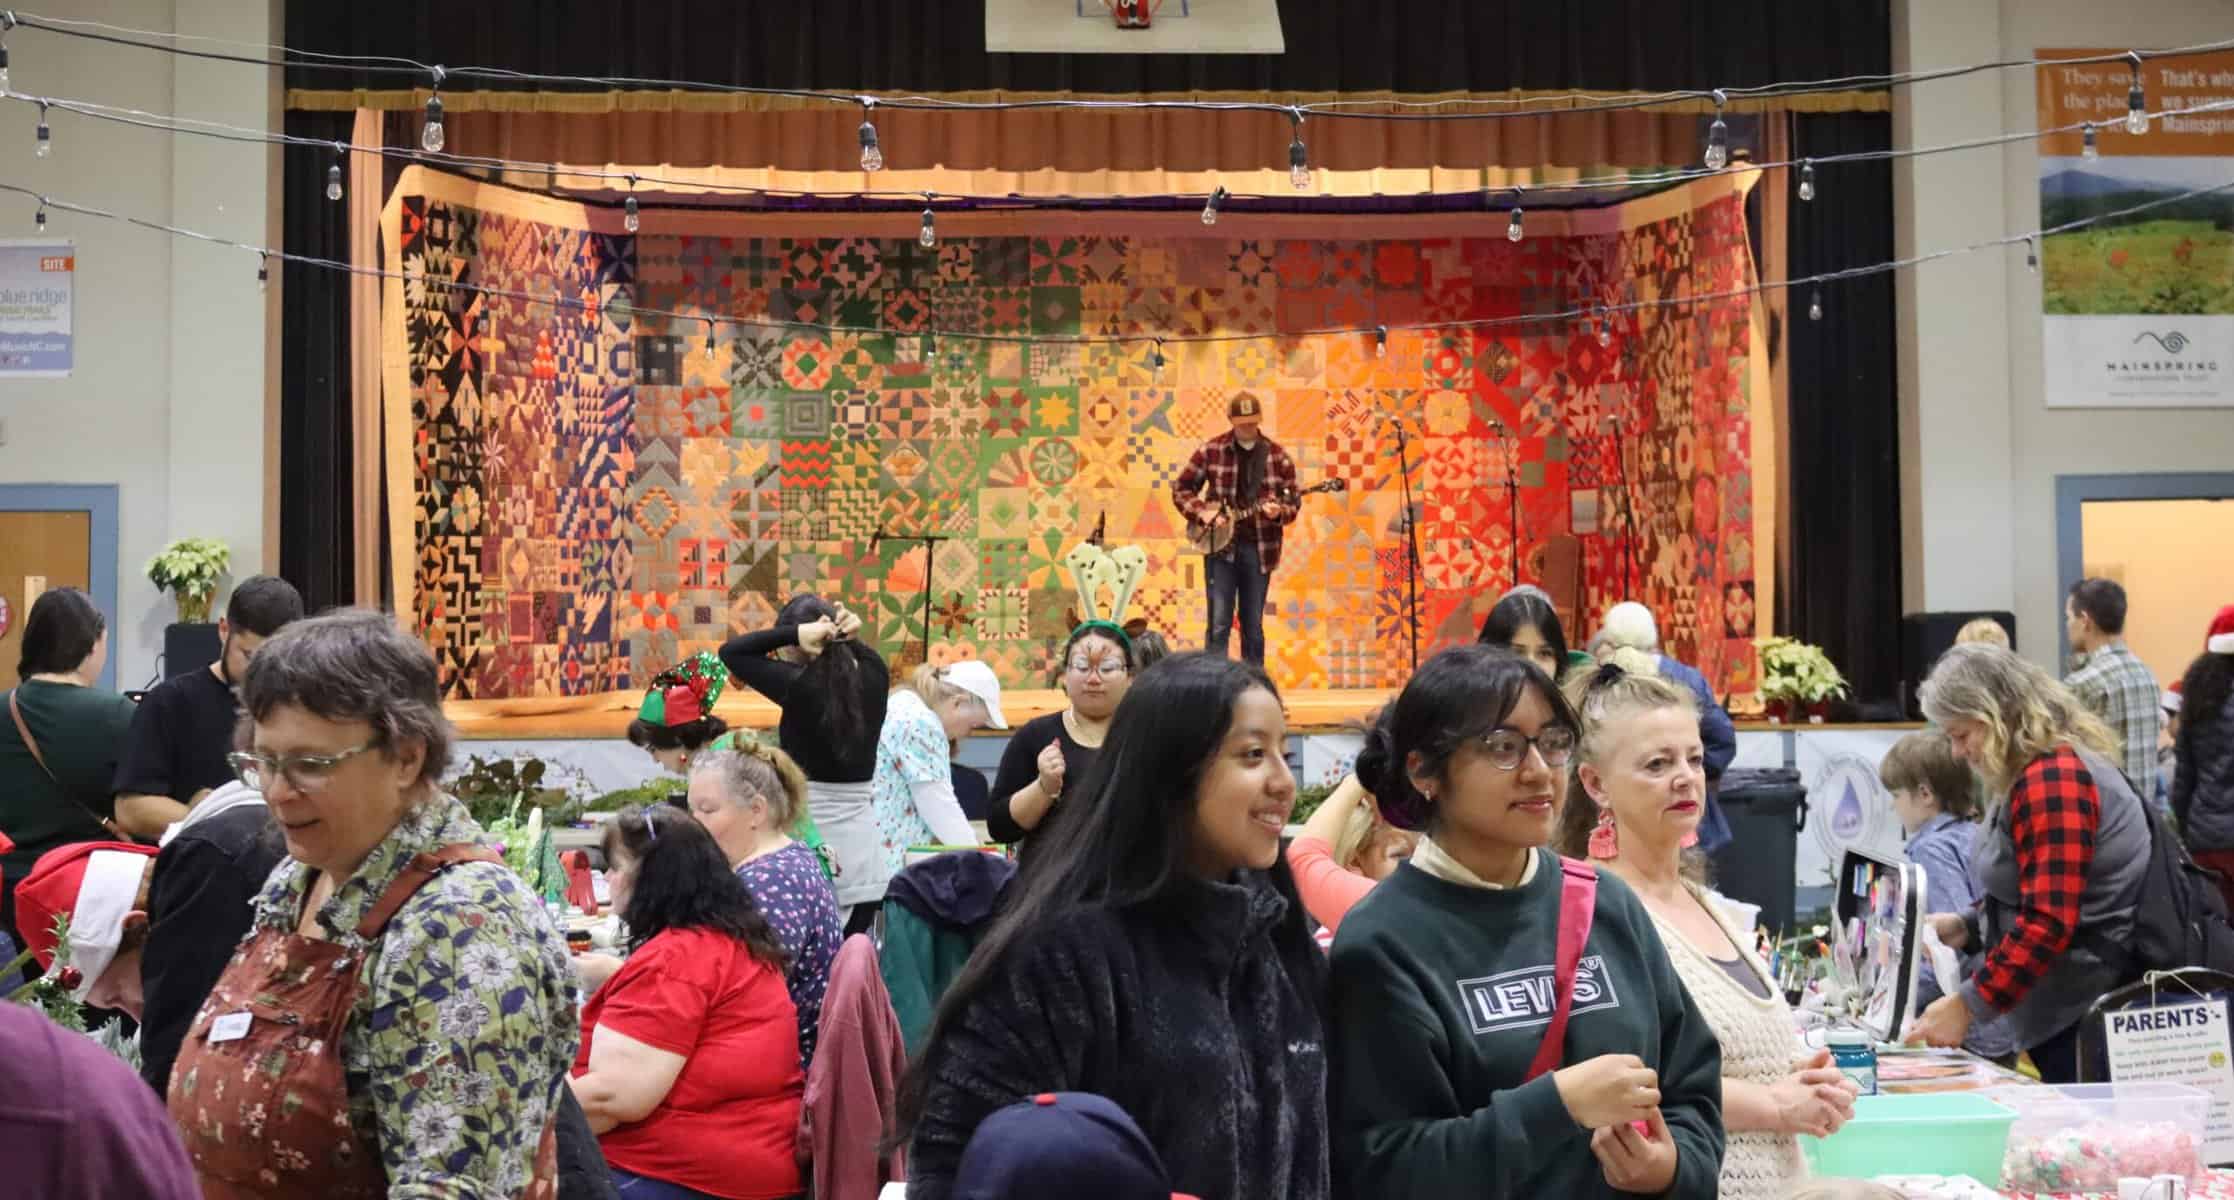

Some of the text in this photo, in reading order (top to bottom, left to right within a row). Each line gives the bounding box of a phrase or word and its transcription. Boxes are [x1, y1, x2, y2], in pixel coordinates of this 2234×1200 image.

[2064, 67, 2101, 89] They
[2160, 69, 2206, 87] That's
[2064, 92, 2130, 112] the plac
[2161, 96, 2183, 109] we
[44, 259, 65, 271] SITE
[31, 288, 66, 306] ridge
[2106, 361, 2217, 371] MAINSPRING
[1474, 968, 1601, 1021] LEVIS
